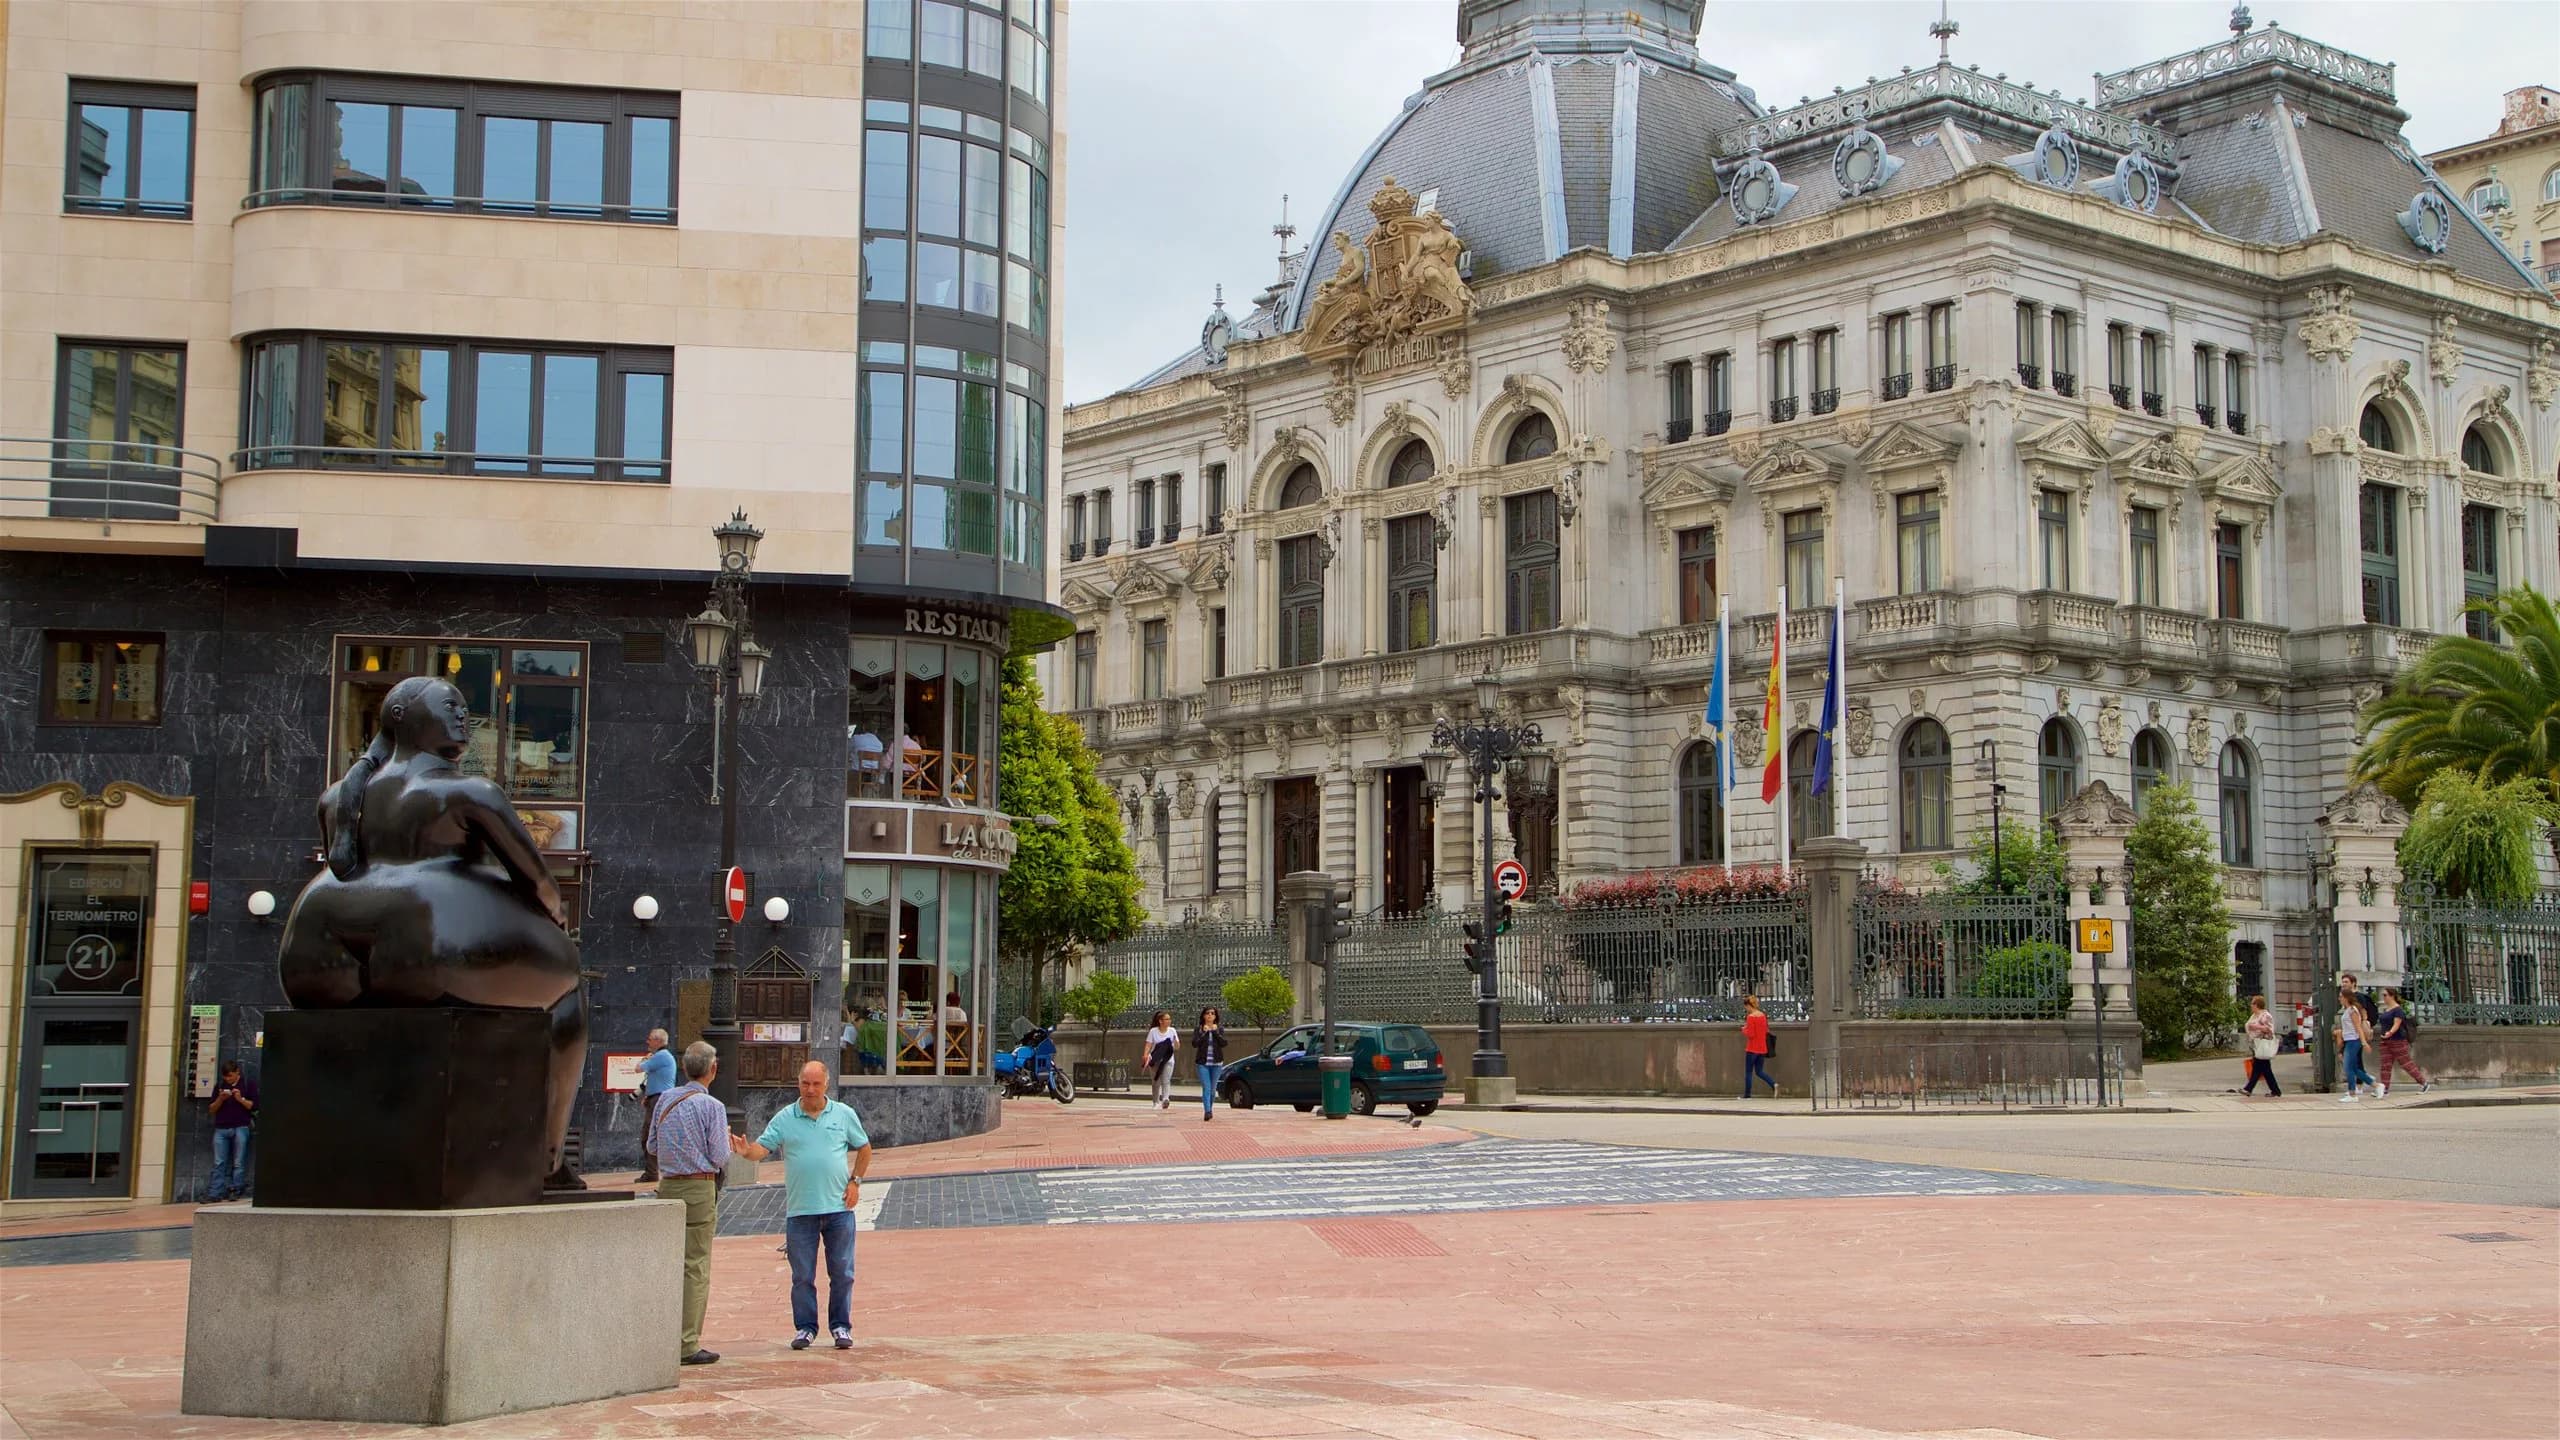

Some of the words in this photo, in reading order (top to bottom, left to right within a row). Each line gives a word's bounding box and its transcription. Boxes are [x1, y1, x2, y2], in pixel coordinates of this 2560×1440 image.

[1361, 347, 1391, 375] JUNTA
[1392, 336, 1435, 367] GENERAL
[942, 822, 978, 847] LA
[952, 846, 976, 860] de
[69, 878, 123, 889] EDIFICIO
[86, 895, 103, 905] EL
[49, 910, 138, 922] TERMOMETRO
[74, 945, 109, 969] 21
